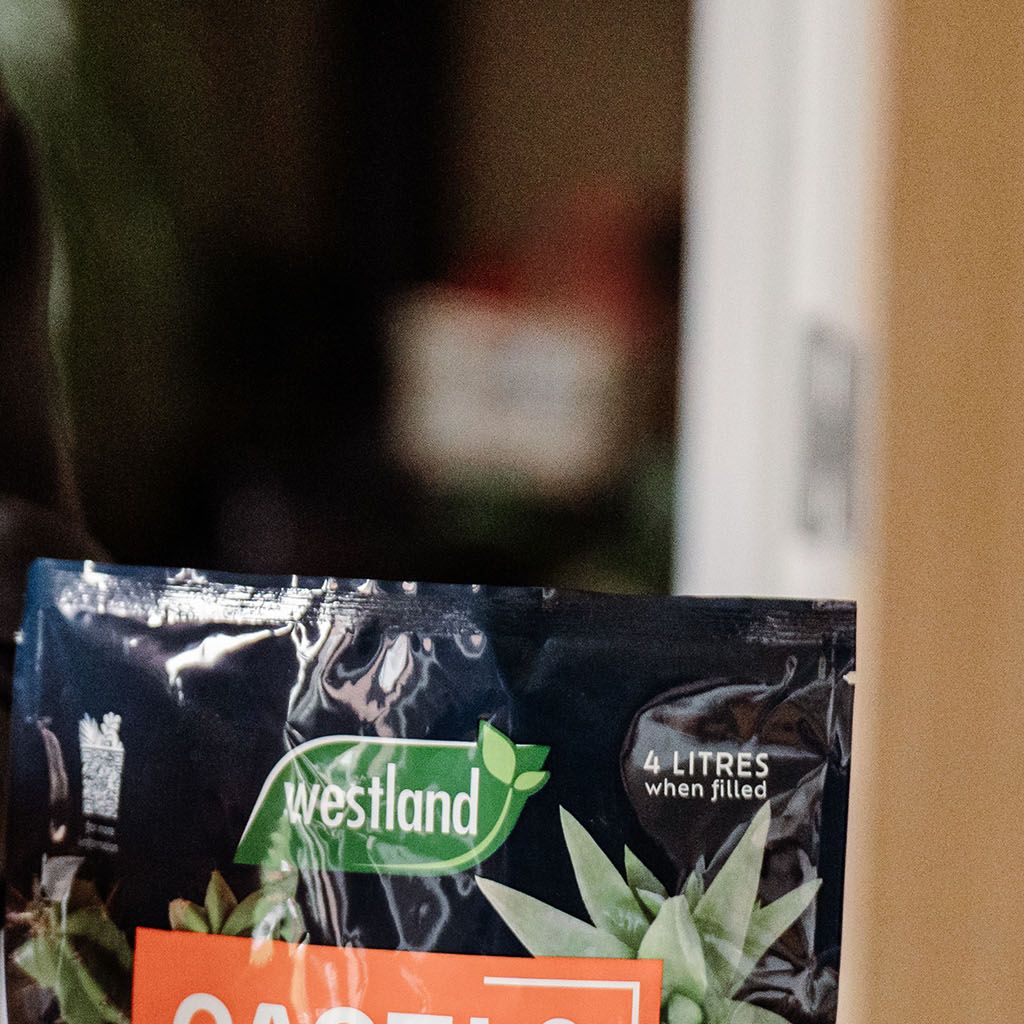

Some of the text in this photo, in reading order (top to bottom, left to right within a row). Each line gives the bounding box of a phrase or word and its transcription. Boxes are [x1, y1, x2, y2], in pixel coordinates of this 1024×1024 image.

[643, 750, 769, 777] 4 LITRES
[284, 763, 480, 835] westland
[644, 778, 767, 802] when filled
